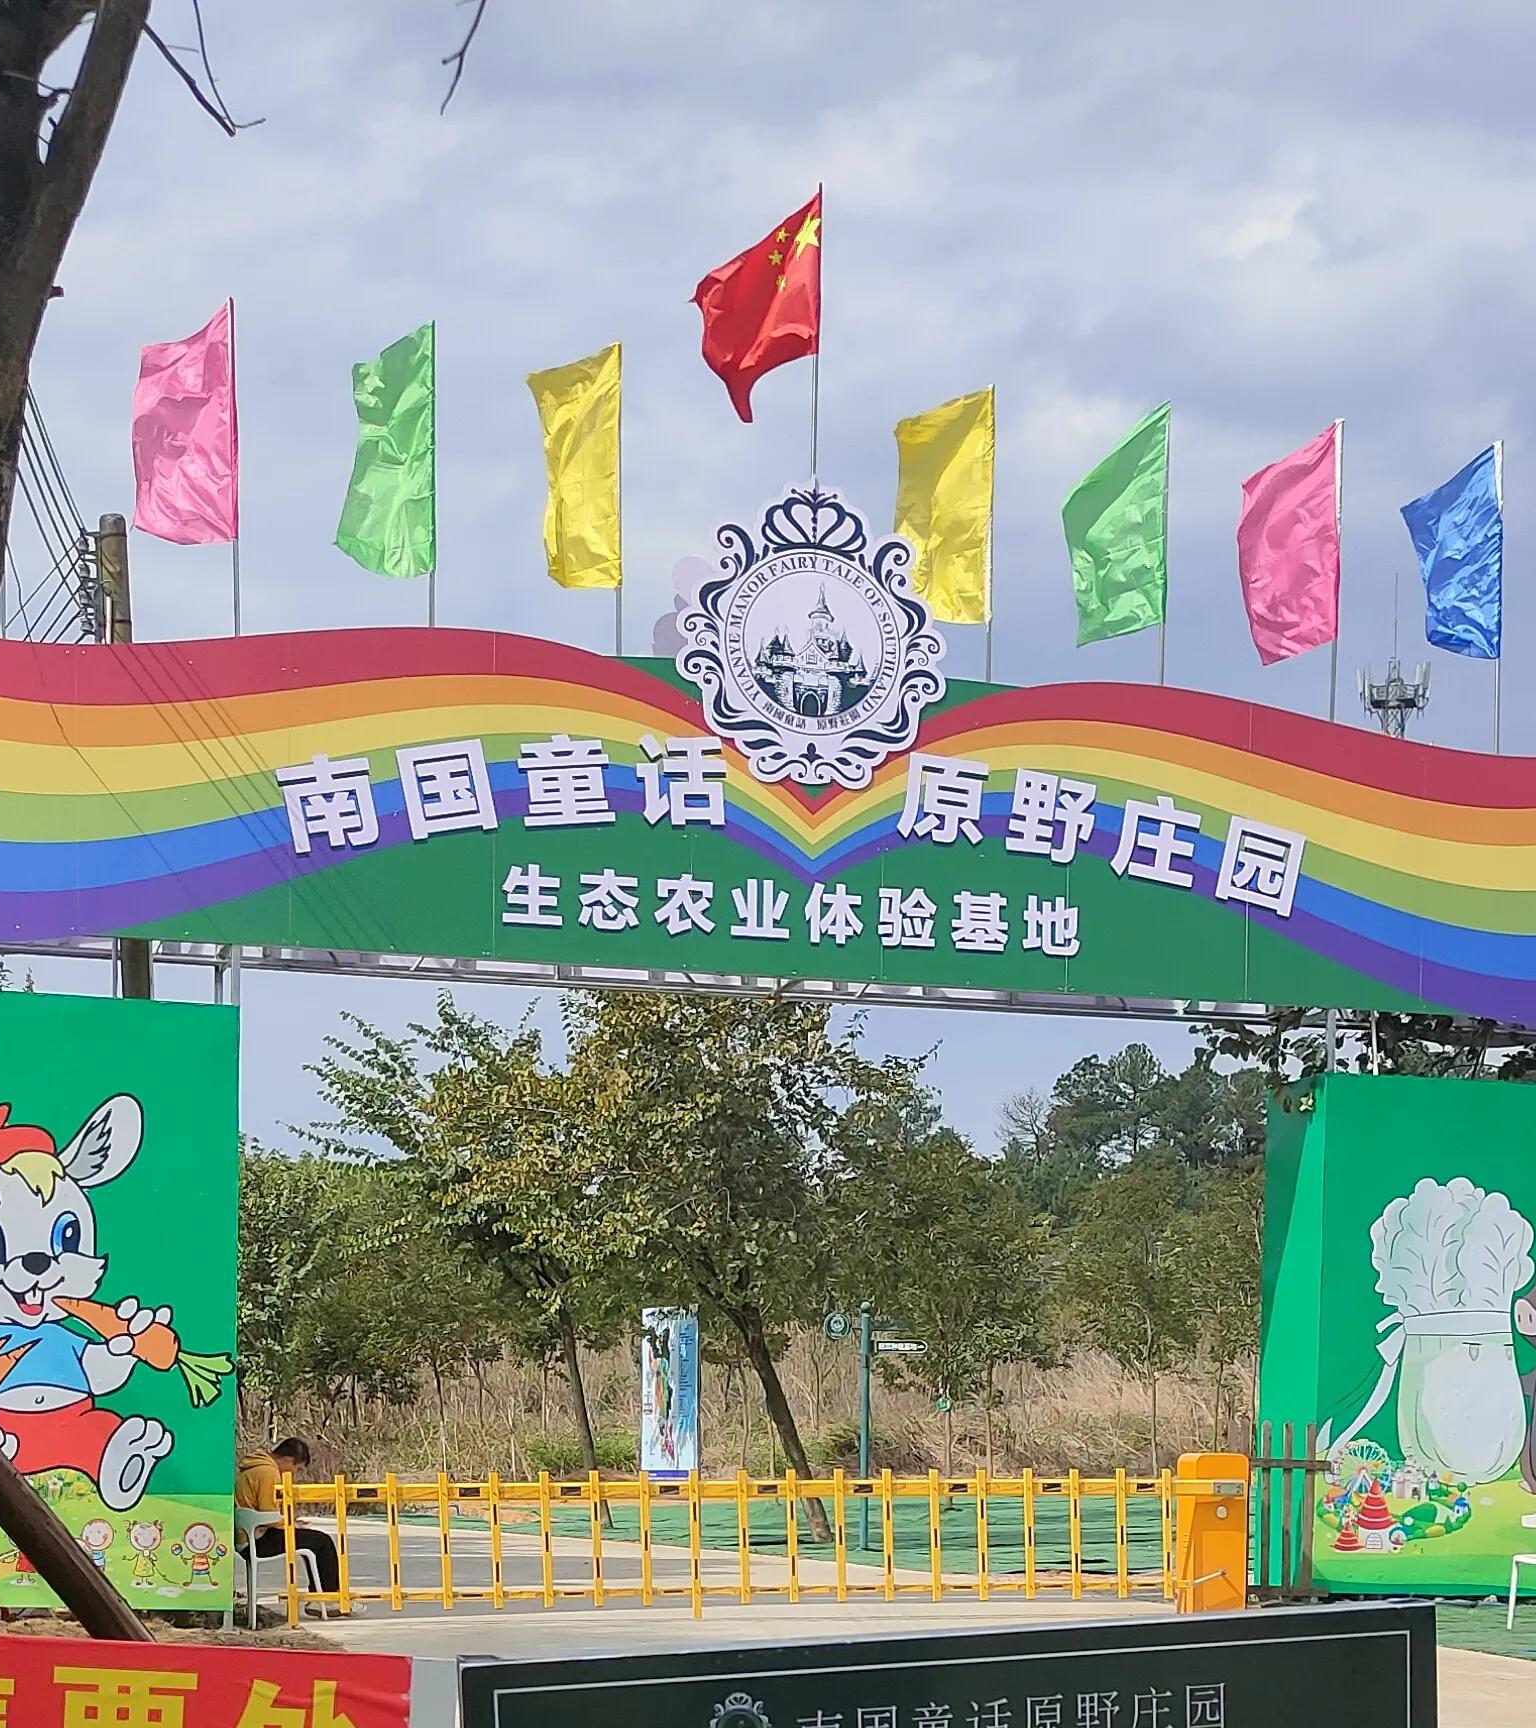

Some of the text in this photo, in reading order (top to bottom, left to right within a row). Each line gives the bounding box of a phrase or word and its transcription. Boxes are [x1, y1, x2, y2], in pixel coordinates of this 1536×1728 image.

[729, 556, 897, 713] YUANYE MANOR FAIRY TALE OF SOUTHLAND
[275, 733, 1307, 919] 南国童话 原野庄园
[500, 862, 1082, 957] 生态农业体验基地
